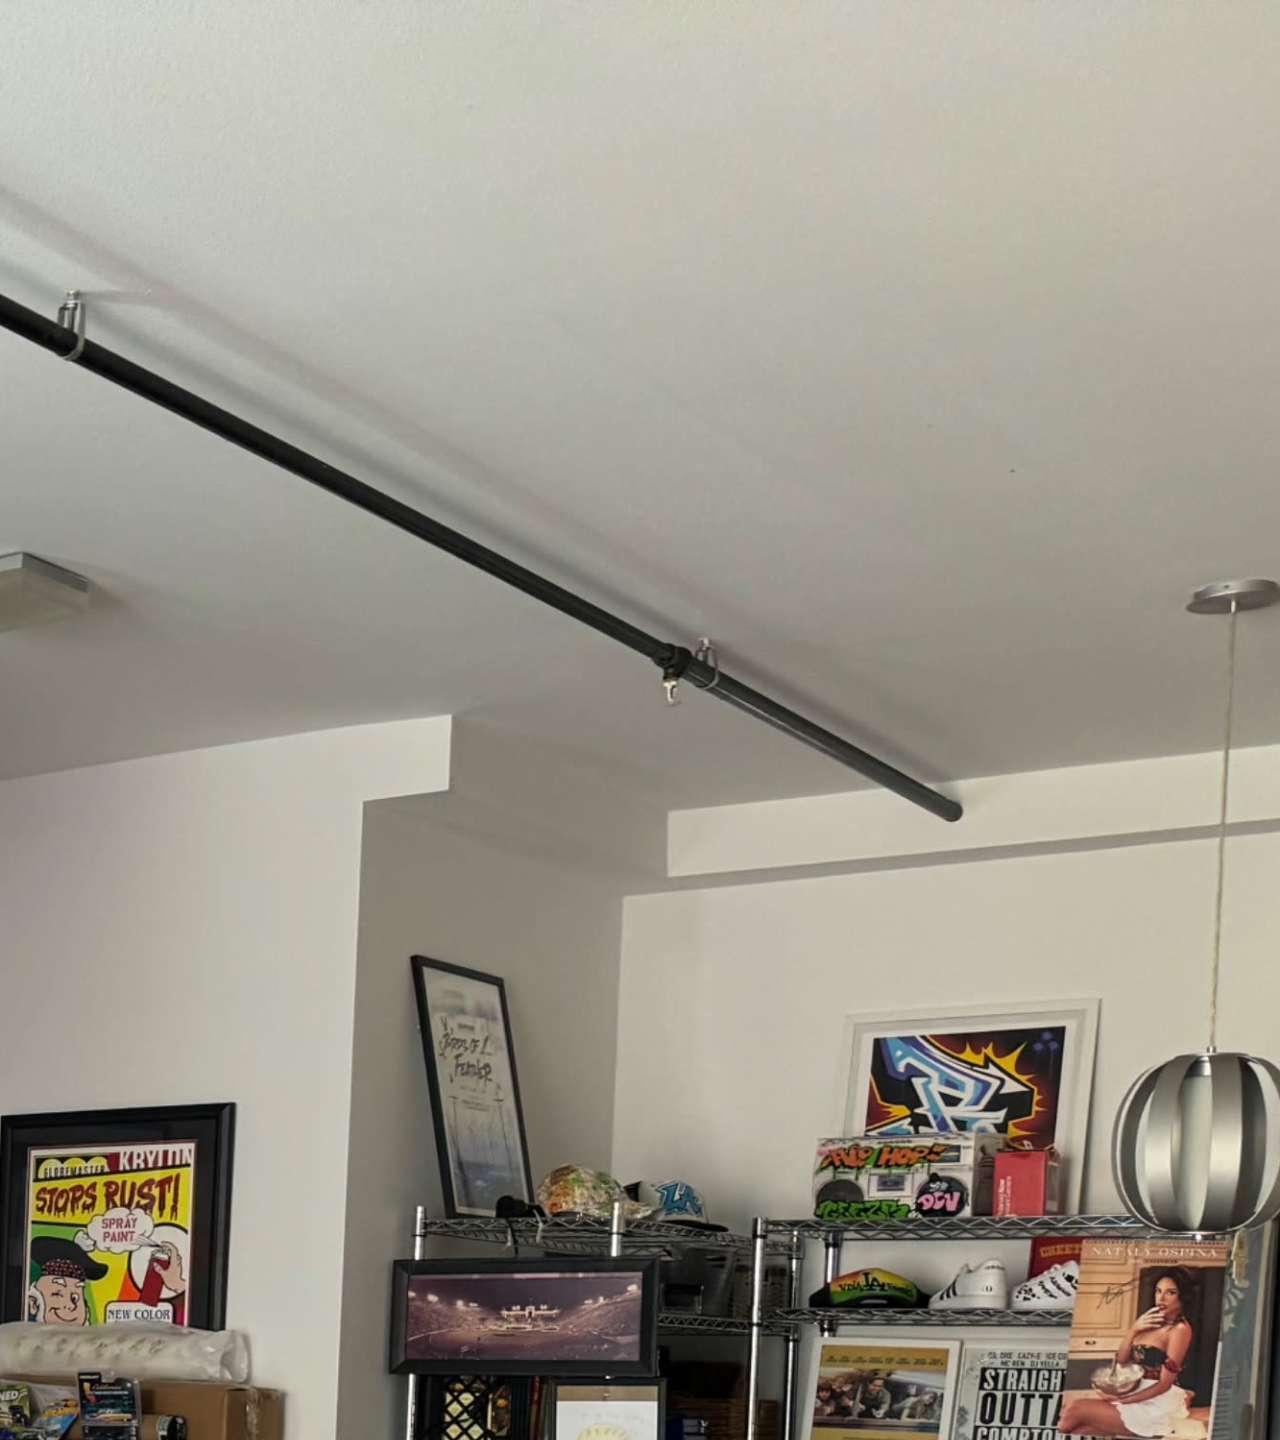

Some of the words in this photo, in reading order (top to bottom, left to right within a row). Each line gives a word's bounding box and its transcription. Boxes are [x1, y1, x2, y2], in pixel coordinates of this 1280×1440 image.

[35, 1180, 99, 1218] STOPS
[102, 1173, 181, 1221] RUST!
[101, 1217, 138, 1230] SPRAY
[103, 1230, 137, 1243] PAINT
[1092, 1246, 1153, 1258] NATALY
[1158, 1247, 1218, 1258] OSPINA
[107, 1309, 132, 1321] NEW
[134, 1309, 171, 1321] COLOR
[983, 1369, 1066, 1391] STRAIGH
